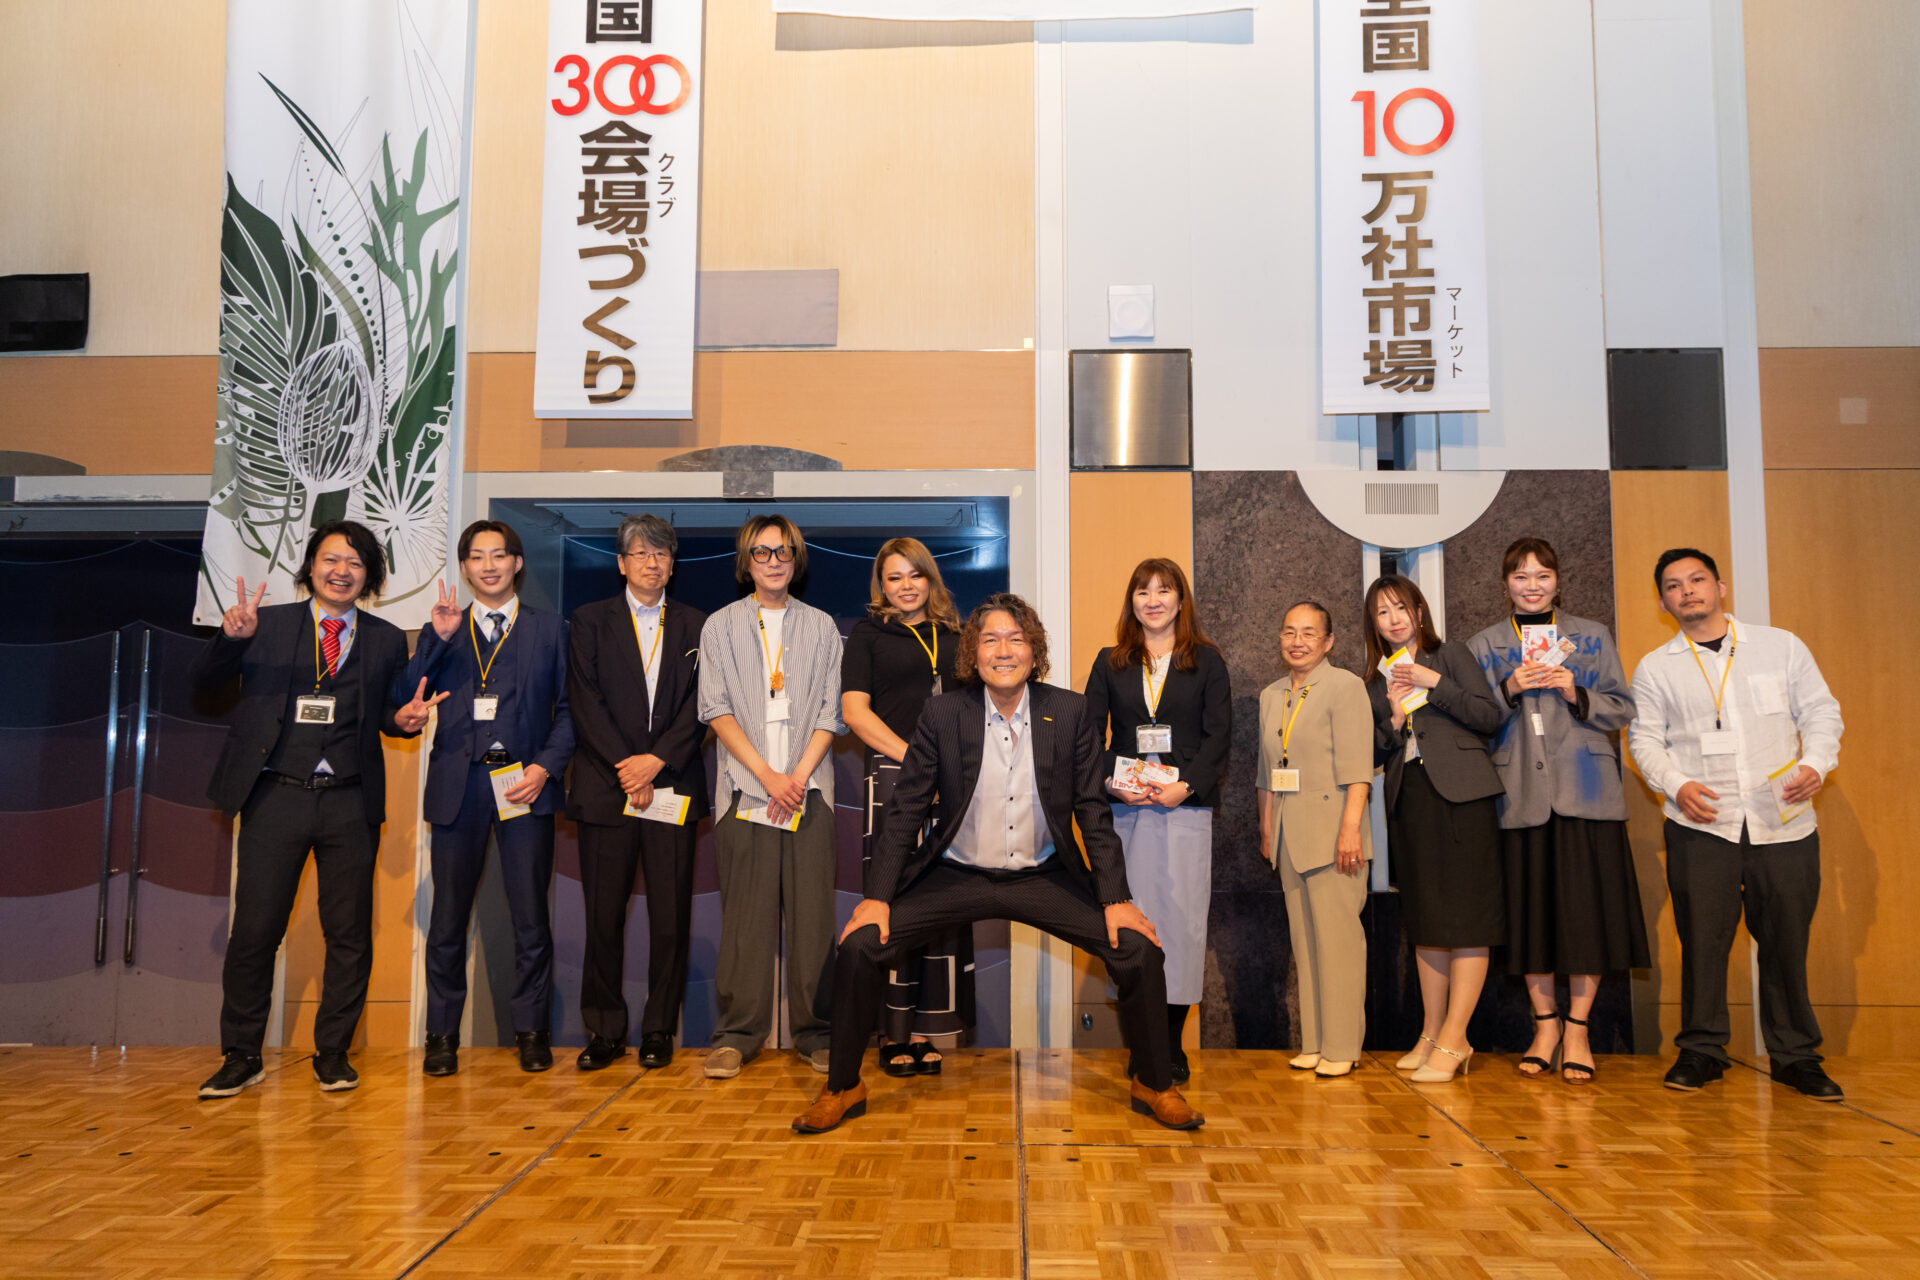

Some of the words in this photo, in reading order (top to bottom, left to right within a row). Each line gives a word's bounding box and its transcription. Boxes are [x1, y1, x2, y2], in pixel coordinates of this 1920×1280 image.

[657, 152, 677, 219] クラブ
[1446, 286, 1464, 379] マーケット
